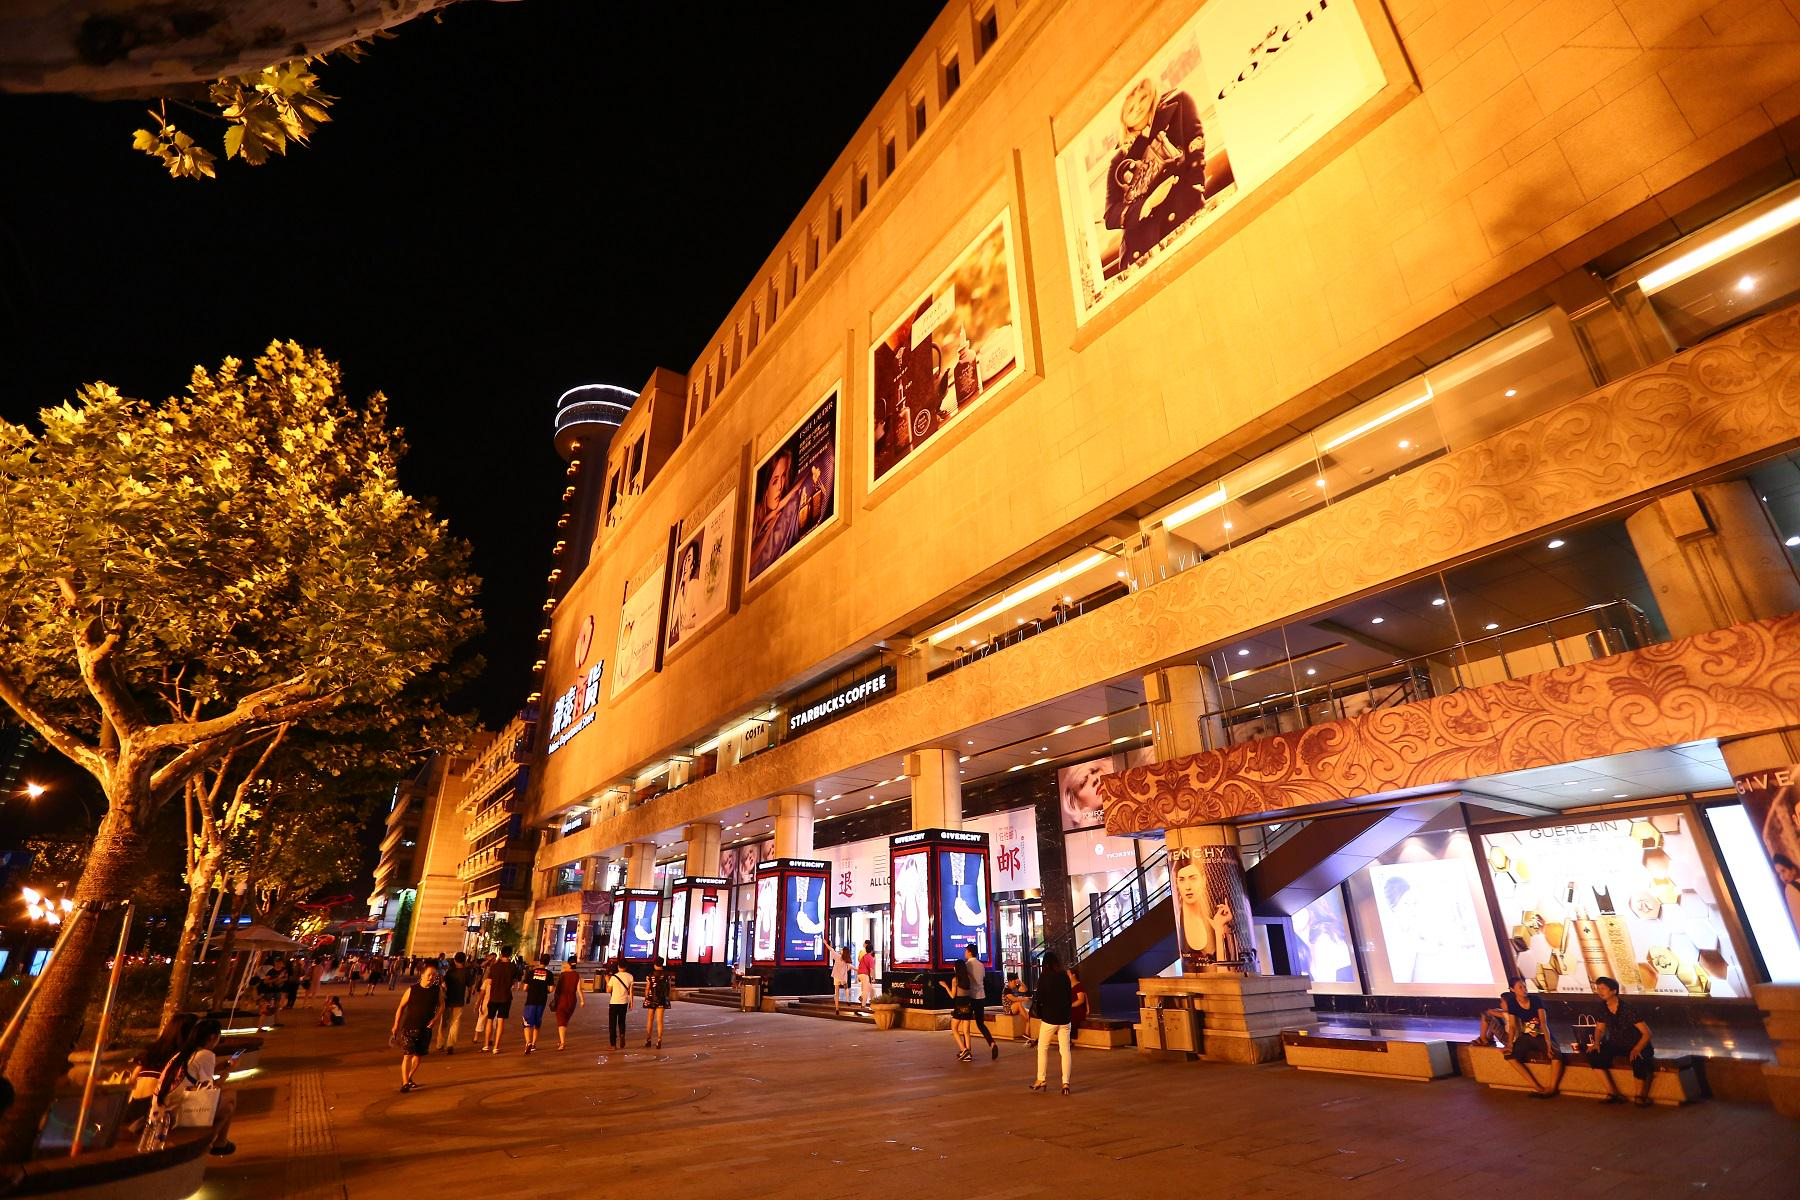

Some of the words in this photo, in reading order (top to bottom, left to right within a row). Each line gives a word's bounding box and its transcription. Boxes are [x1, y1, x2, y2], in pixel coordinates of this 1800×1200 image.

[1217, 0, 1328, 101] COACH
[790, 693, 846, 730] STARBUCKS
[845, 674, 886, 704] COFFEE
[745, 723, 765, 741] COSTA
[1735, 770, 1795, 795] GIVE
[940, 831, 982, 842] GIVENCHY
[1529, 821, 1618, 839] GUERLAIN
[789, 860, 825, 868] GIVENCHY
[996, 844, 1021, 881] 邮
[838, 870, 854, 898] 退
[869, 877, 882, 888] ALL
